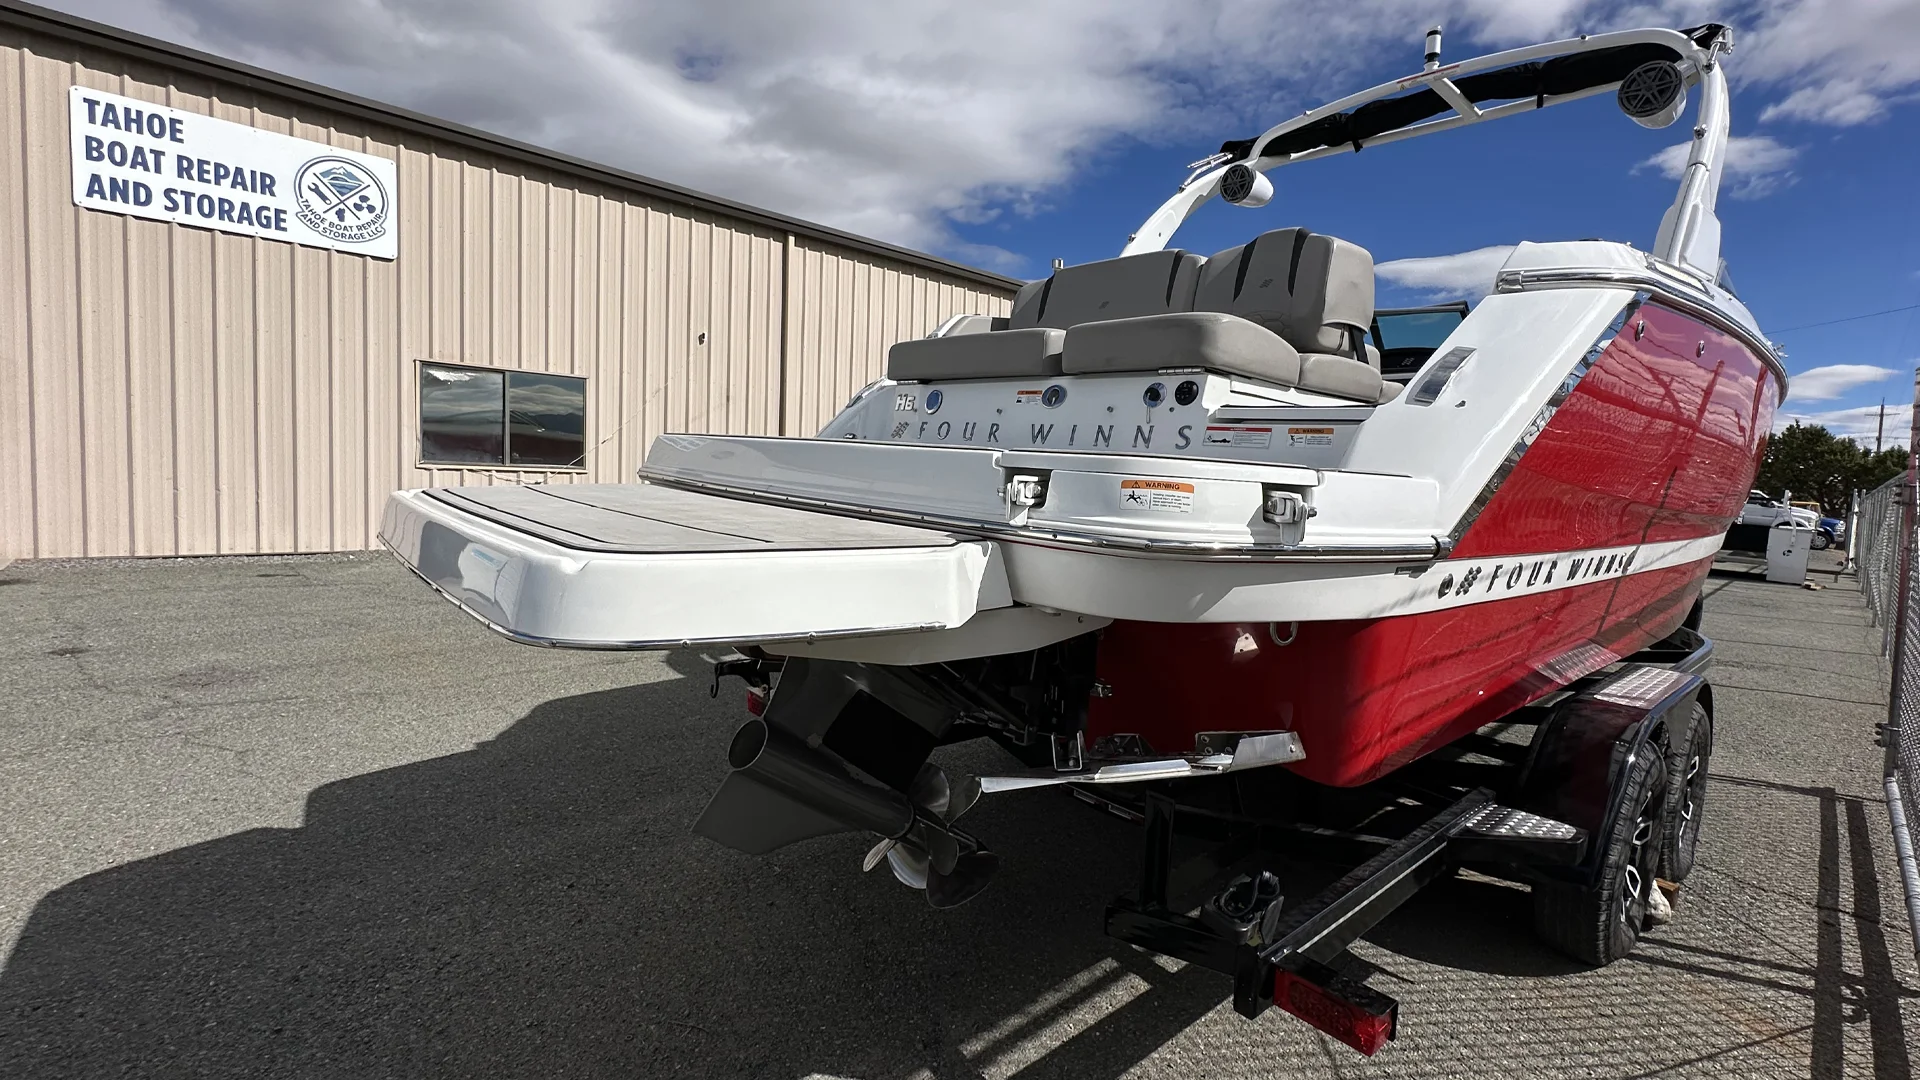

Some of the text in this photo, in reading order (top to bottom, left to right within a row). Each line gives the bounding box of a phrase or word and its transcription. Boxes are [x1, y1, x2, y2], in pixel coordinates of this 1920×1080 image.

[83, 97, 185, 144] TAHOE
[84, 135, 277, 197] BOAT REPAIR
[86, 173, 288, 232] AND STORAGE
[301, 199, 383, 232] TAHOE BOAT REPAIR
[300, 213, 382, 240] AND STORAGE LLC
[917, 421, 1193, 450] FOUR WINNS
[1145, 481, 1180, 490] WARNING
[1485, 552, 1627, 593] FOUR WINNS
